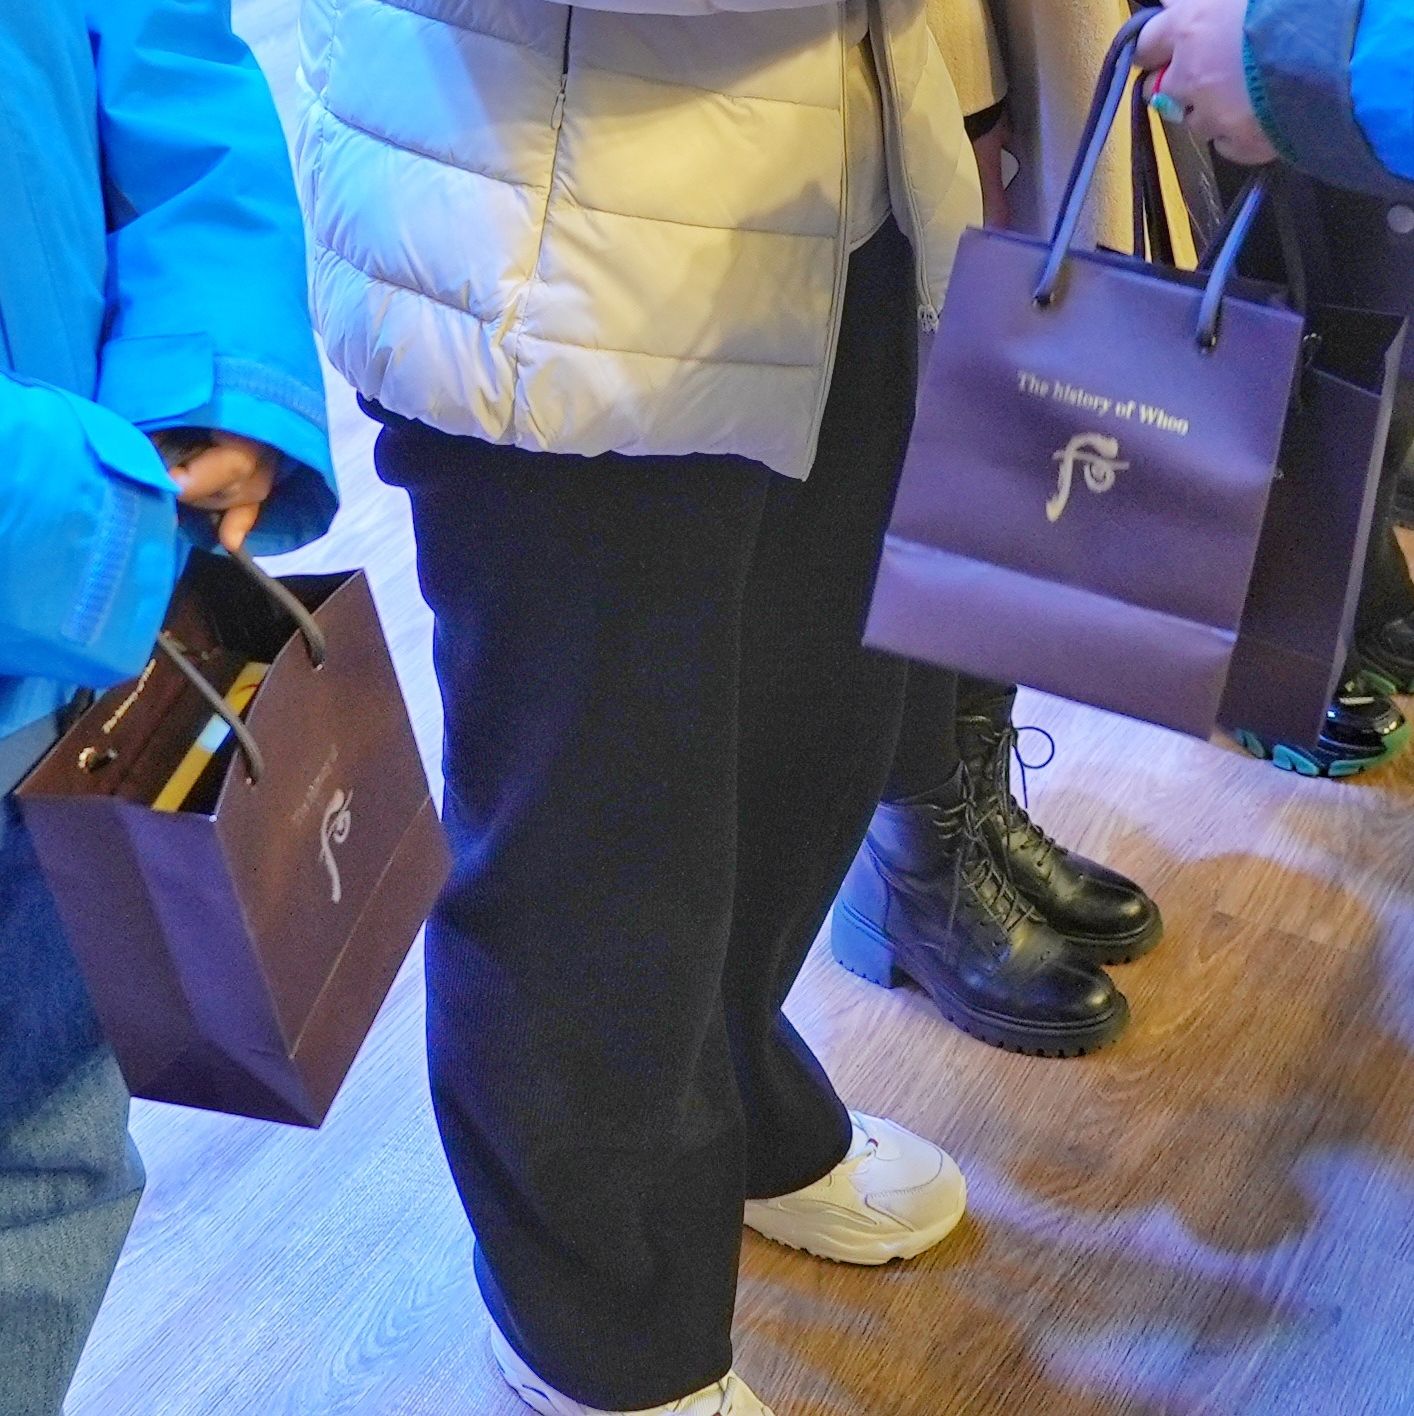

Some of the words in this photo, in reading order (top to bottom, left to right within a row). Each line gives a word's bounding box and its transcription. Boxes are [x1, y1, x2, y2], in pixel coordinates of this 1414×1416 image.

[1017, 369, 1050, 398] The
[1053, 381, 1112, 417] history
[1115, 399, 1136, 421] of
